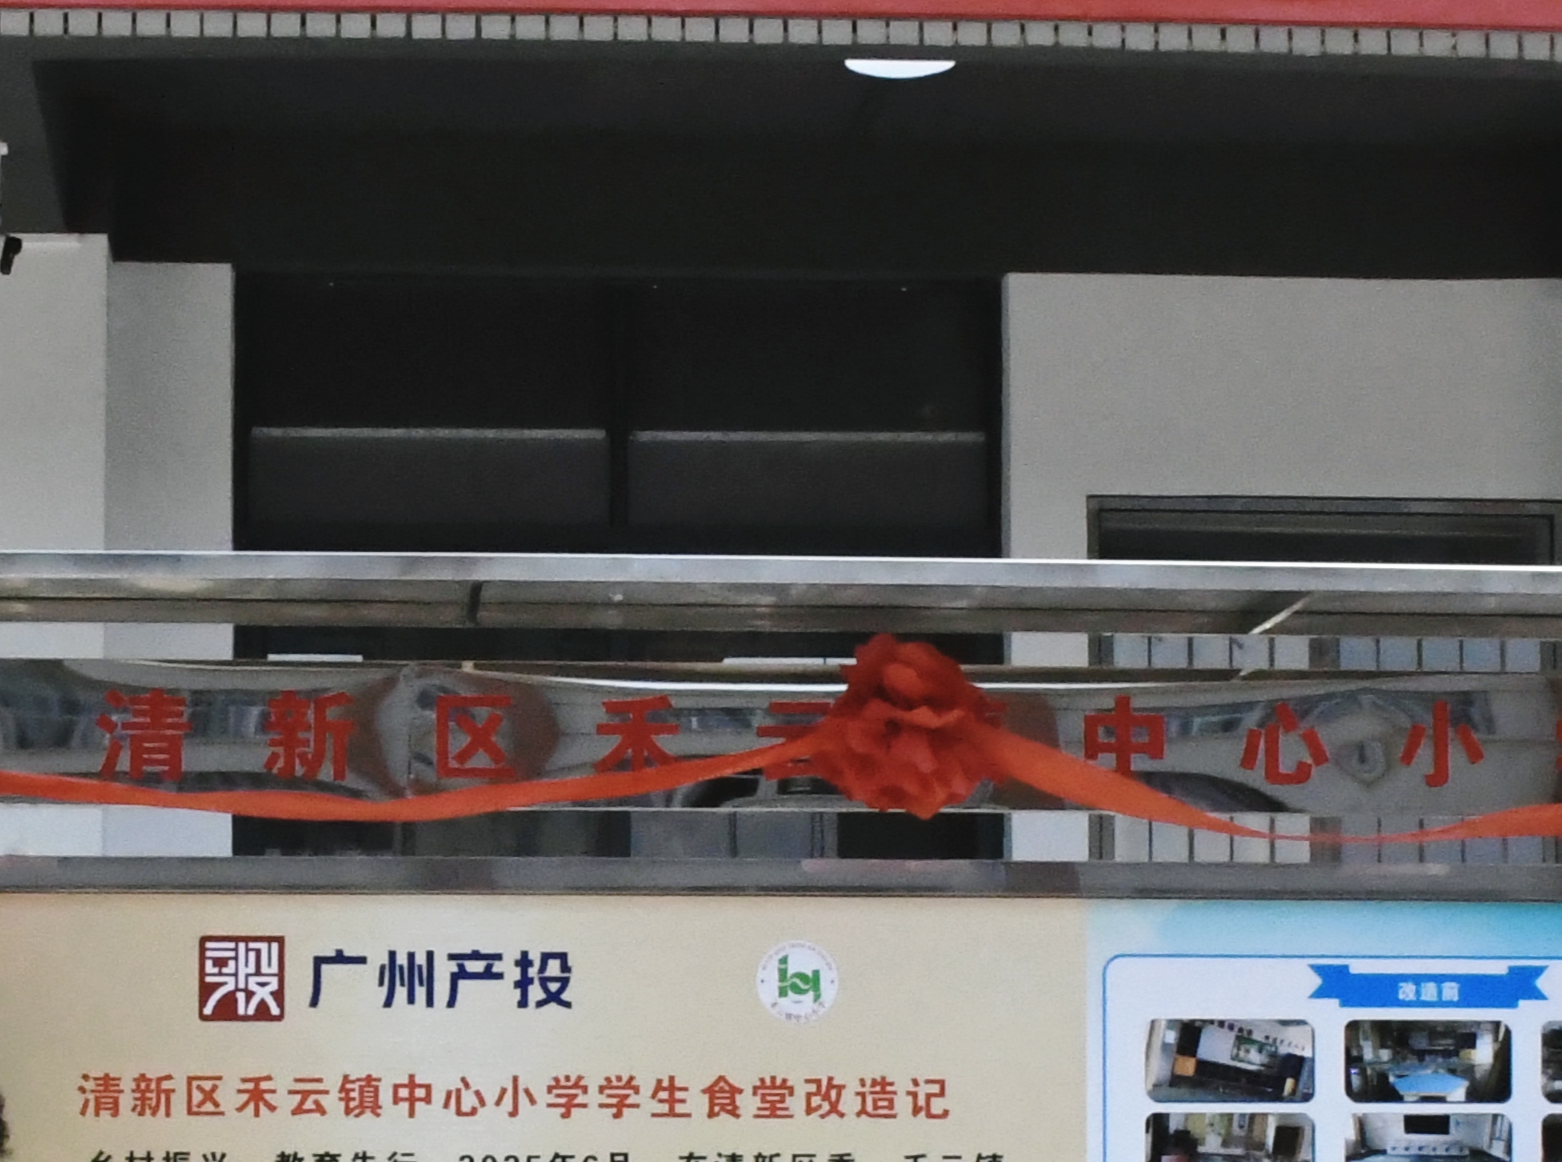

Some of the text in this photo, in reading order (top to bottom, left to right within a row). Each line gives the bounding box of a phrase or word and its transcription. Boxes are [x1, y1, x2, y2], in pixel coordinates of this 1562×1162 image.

[308, 948, 573, 1010] 广州产投
[78, 1073, 951, 1120] 清新区禾云镇中心小学学生食堂改造记
